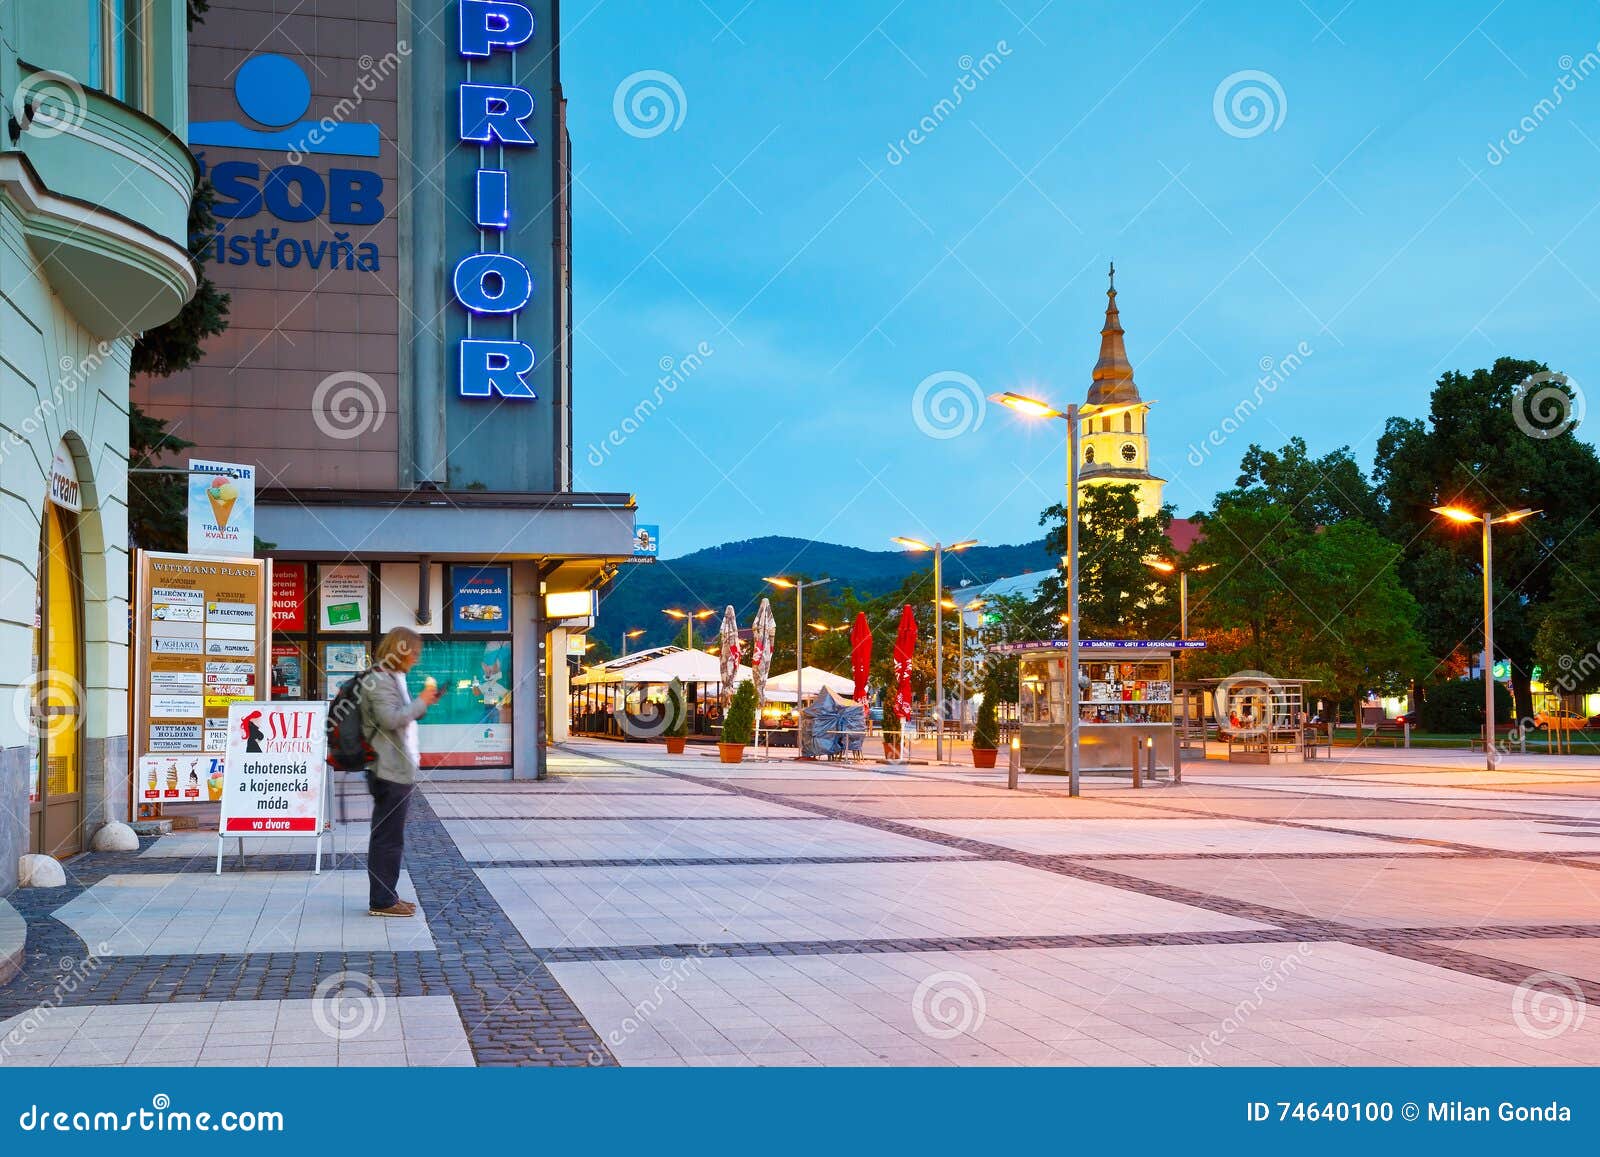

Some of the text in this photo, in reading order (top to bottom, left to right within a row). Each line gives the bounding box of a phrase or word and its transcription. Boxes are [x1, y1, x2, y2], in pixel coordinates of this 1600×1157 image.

[195, 152, 385, 225] SOB
[455, 0, 537, 400] PRIOR
[190, 222, 381, 273] isťovňa
[52, 472, 79, 506] cream
[205, 531, 239, 540] KVALITA
[632, 543, 657, 552] SOB
[152, 563, 257, 577] WITTMANN PLACE
[153, 590, 187, 598] MLIEČNY
[279, 589, 295, 597] deti
[459, 587, 503, 596] www.pss.sk
[272, 600, 298, 608] NIOR
[161, 640, 199, 650] AGHARTA
[266, 711, 317, 741] SVET
[243, 761, 307, 776] tehotenská
[239, 778, 309, 796] a kojenecká
[256, 796, 289, 811] móda
[252, 819, 290, 830] vo dvore
